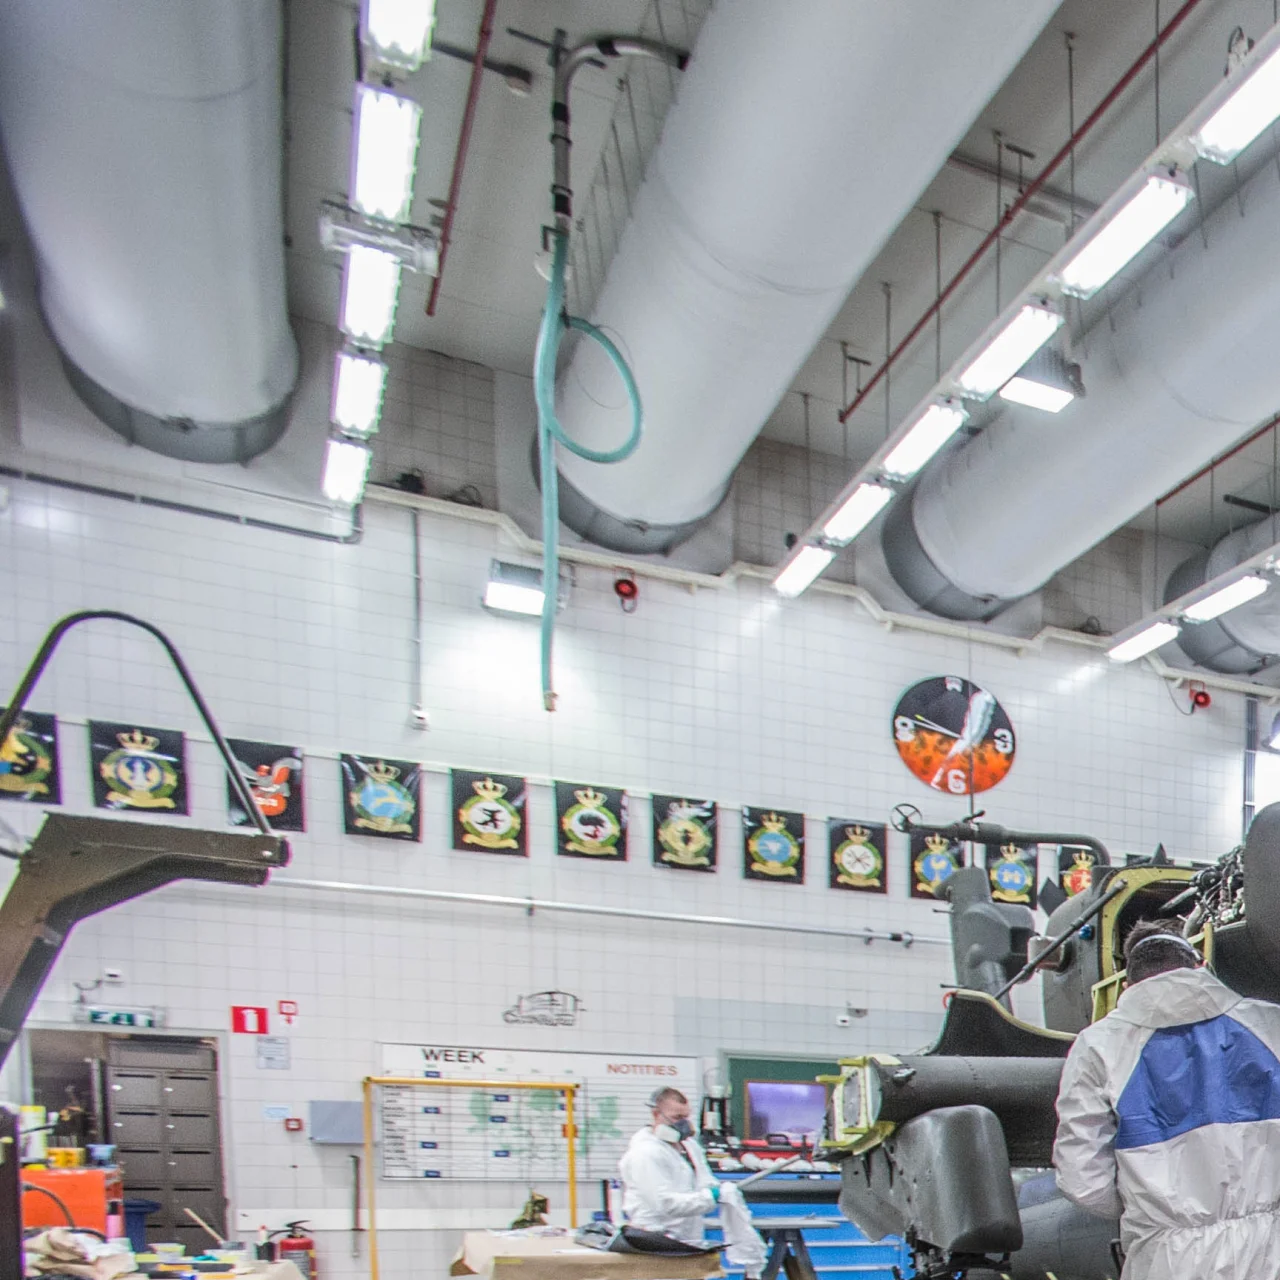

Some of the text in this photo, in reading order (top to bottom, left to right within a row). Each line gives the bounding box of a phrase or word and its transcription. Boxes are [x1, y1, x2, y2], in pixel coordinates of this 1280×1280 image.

[994, 729, 1013, 754] 3
[948, 769, 966, 793] 6
[422, 1048, 484, 1064] WEEK
[607, 1062, 678, 1077] NOTITIES
